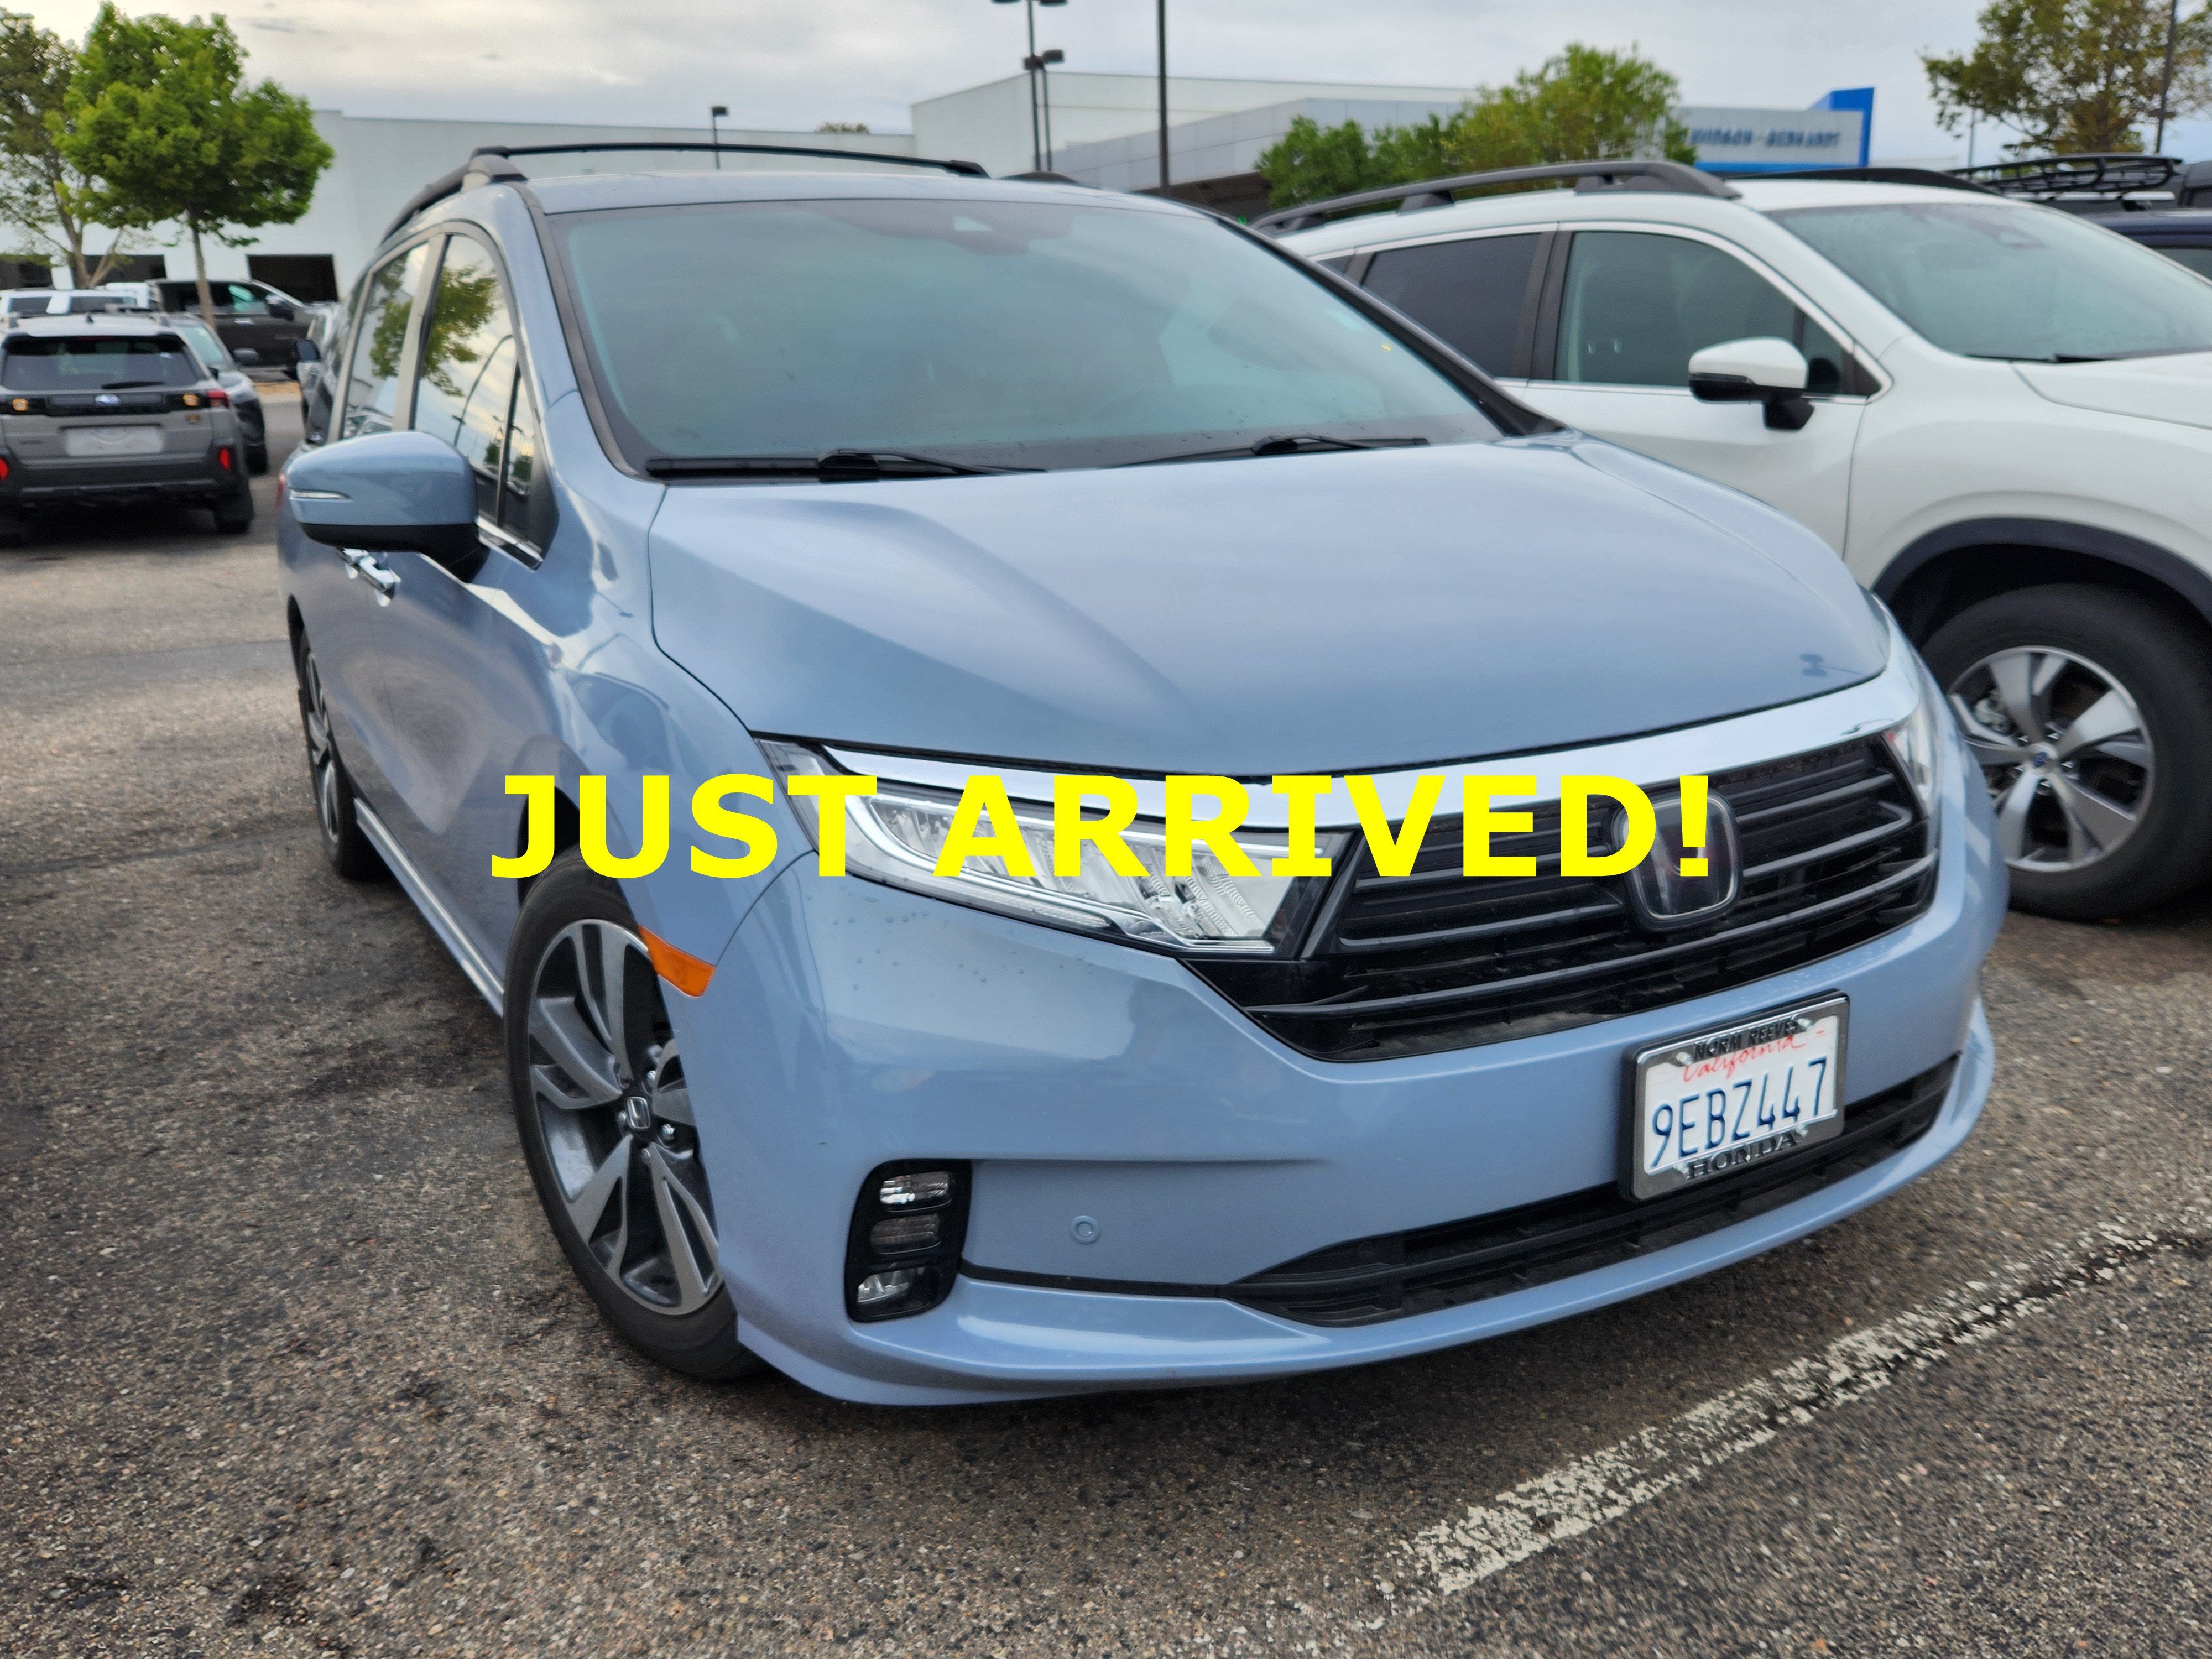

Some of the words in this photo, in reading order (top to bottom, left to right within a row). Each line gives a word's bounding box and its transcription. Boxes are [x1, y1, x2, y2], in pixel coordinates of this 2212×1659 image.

[1693, 1032, 1742, 1060] NORM
[1650, 1056, 1827, 1168] 9EBZ447
[1686, 1130, 1799, 1180] HONDA
